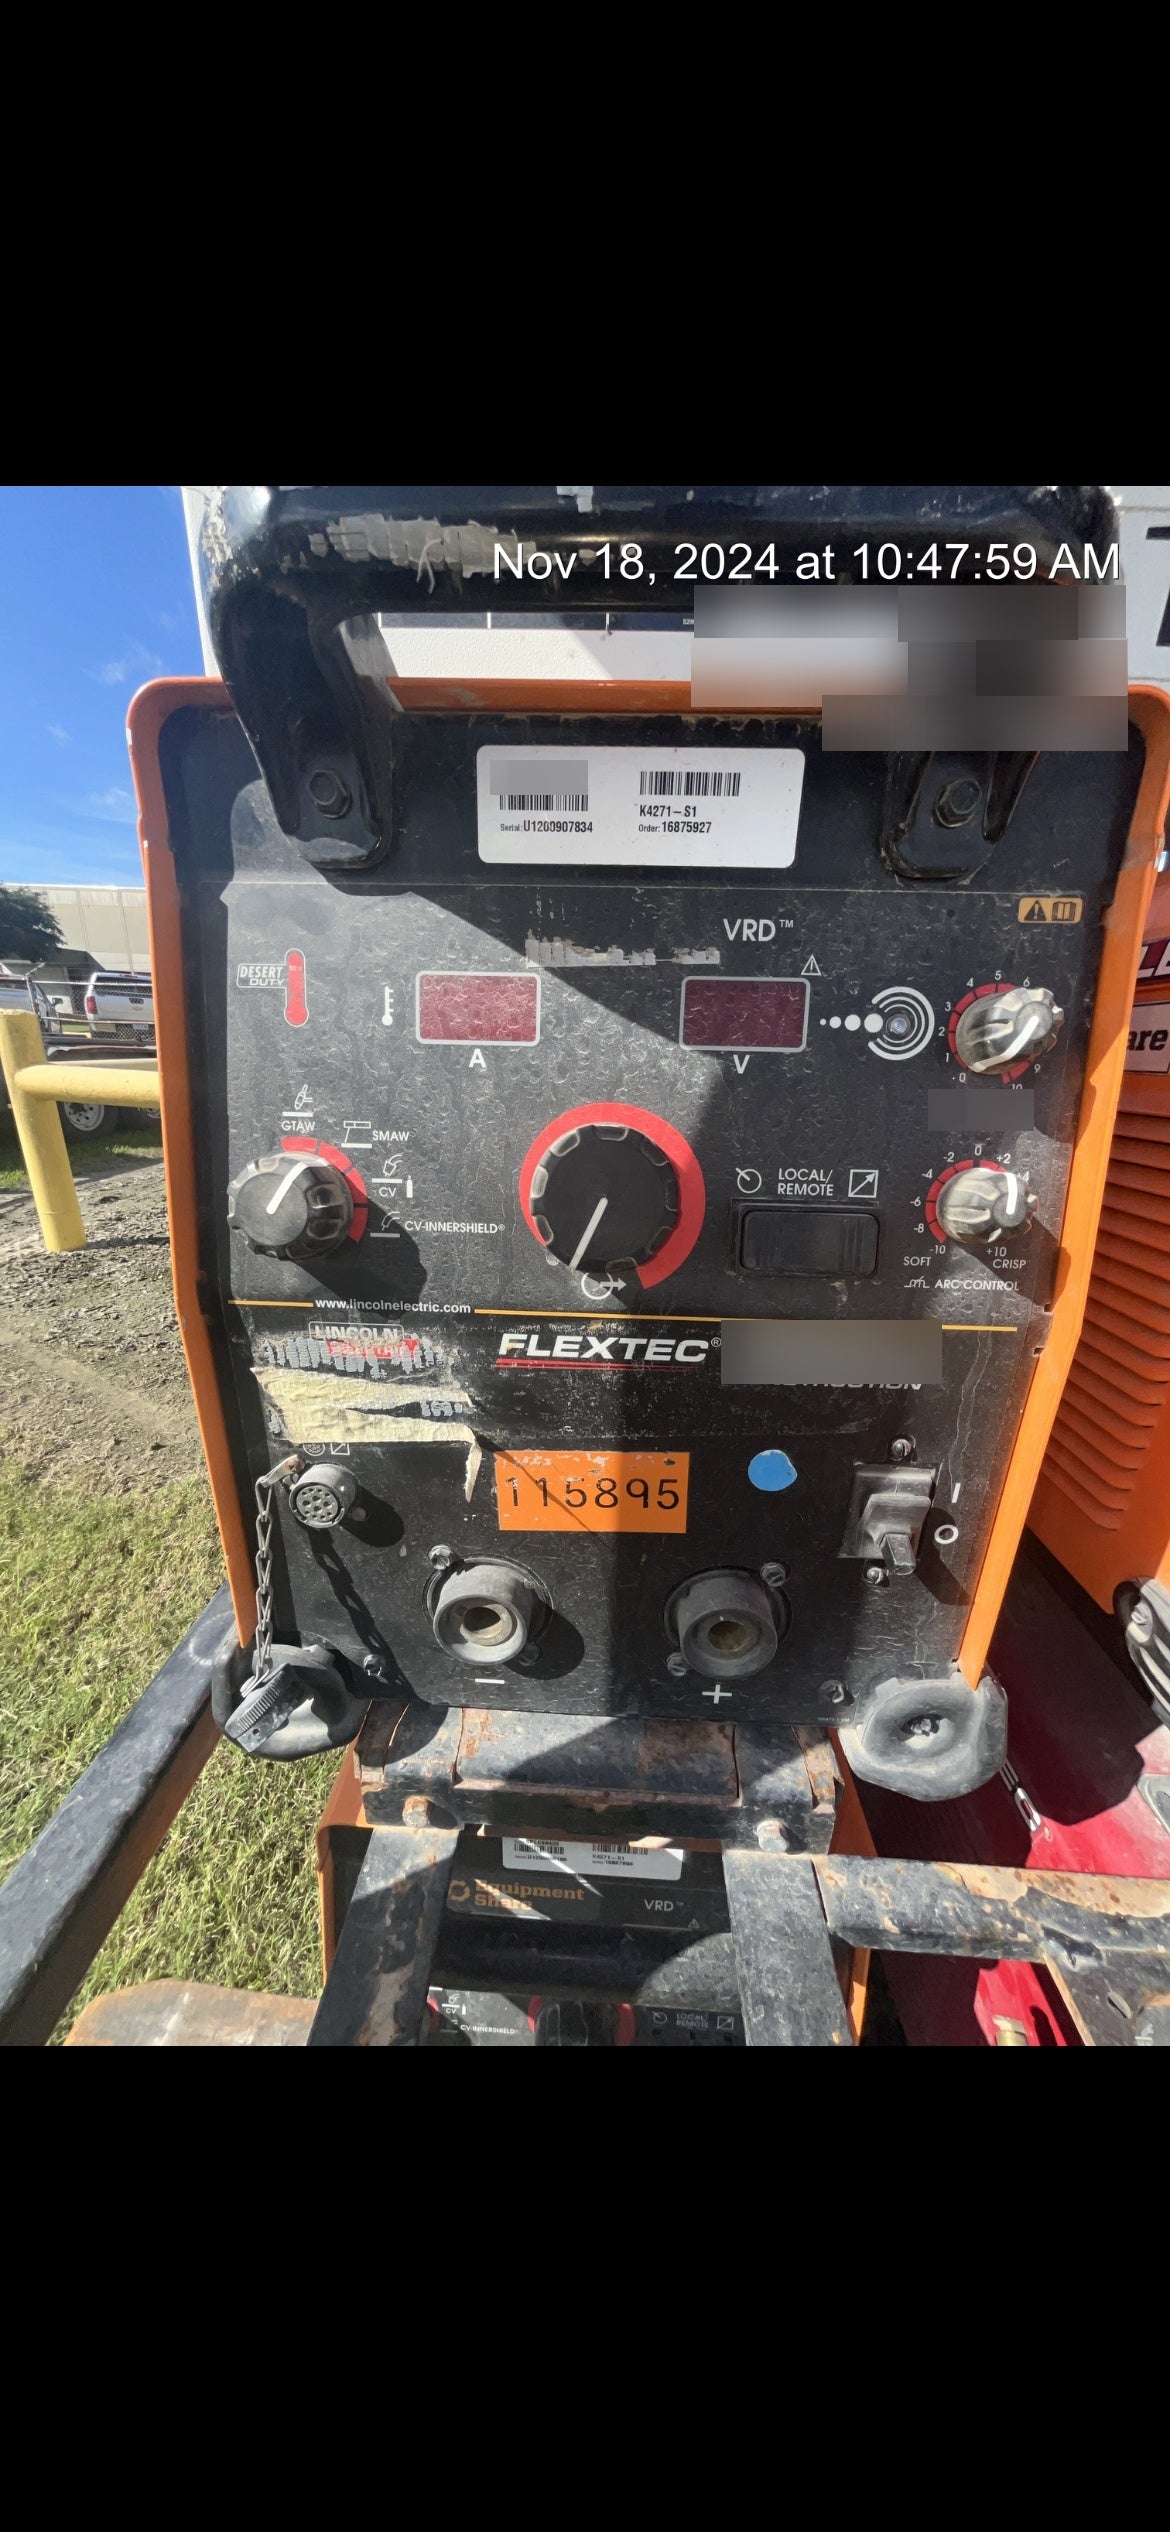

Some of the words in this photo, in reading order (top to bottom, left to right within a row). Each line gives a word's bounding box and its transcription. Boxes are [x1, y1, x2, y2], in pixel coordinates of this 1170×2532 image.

[523, 820, 593, 833] U1200907834
[638, 823, 660, 833] Order:
[662, 822, 712, 833] 16875927
[239, 965, 283, 979] DESERT
[994, 970, 1002, 981] 5
[249, 978, 285, 987] DUTY
[966, 977, 974, 988] 4
[1023, 977, 1030, 987] 6
[944, 1001, 952, 1012] 3
[938, 1026, 945, 1037] 2
[469, 1048, 487, 1069] A
[945, 1052, 950, 1062] 1
[733, 1054, 751, 1075] V
[1034, 1063, 1042, 1074] 9
[281, 1120, 316, 1132] GTAW
[372, 1130, 410, 1142] SMAW
[974, 1144, 983, 1156] 0
[943, 1151, 955, 1163] -2
[996, 1153, 1011, 1165] +2
[777, 1168, 834, 1184] LOCAL/
[921, 1168, 933, 1180] -4
[378, 1186, 397, 1198] CV
[777, 1183, 834, 1197] REMOTE
[910, 1196, 922, 1207] -6
[913, 1223, 925, 1234] -8
[930, 1244, 946, 1255] -10
[986, 1246, 1007, 1257] +10
[903, 1256, 932, 1267] SOFT
[992, 1258, 1027, 1270] CRISP
[934, 1279, 959, 1290] ARC
[963, 1280, 1020, 1291] CONTROL
[315, 1298, 471, 1314] www.lincolnelectric.com
[314, 1325, 399, 1342] LINCOLN
[505, 1476, 680, 1510] 115895
[474, 1879, 584, 1900] Equipment
